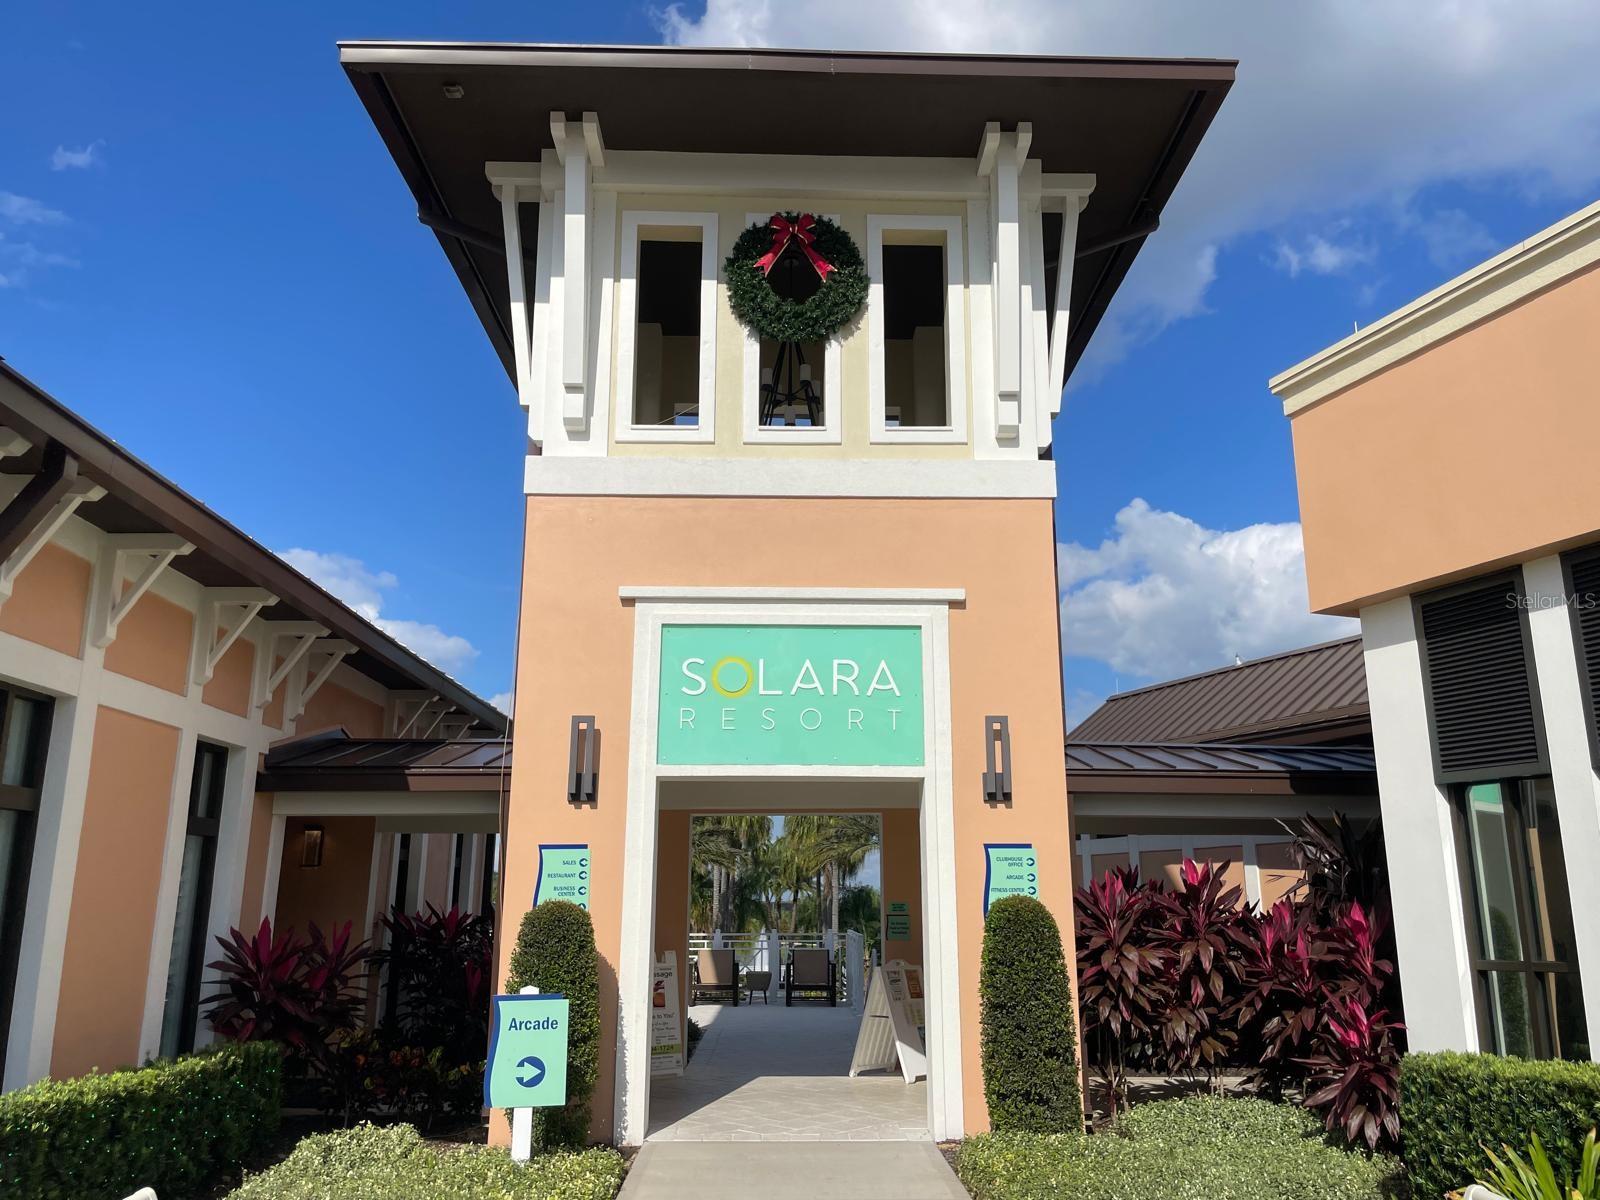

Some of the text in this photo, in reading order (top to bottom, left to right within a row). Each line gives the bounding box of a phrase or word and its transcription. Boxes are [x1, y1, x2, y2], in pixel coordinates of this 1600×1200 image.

[681, 656, 901, 698] SOLARA
[679, 708, 901, 731] RESORT
[508, 1017, 559, 1031] Arcade
